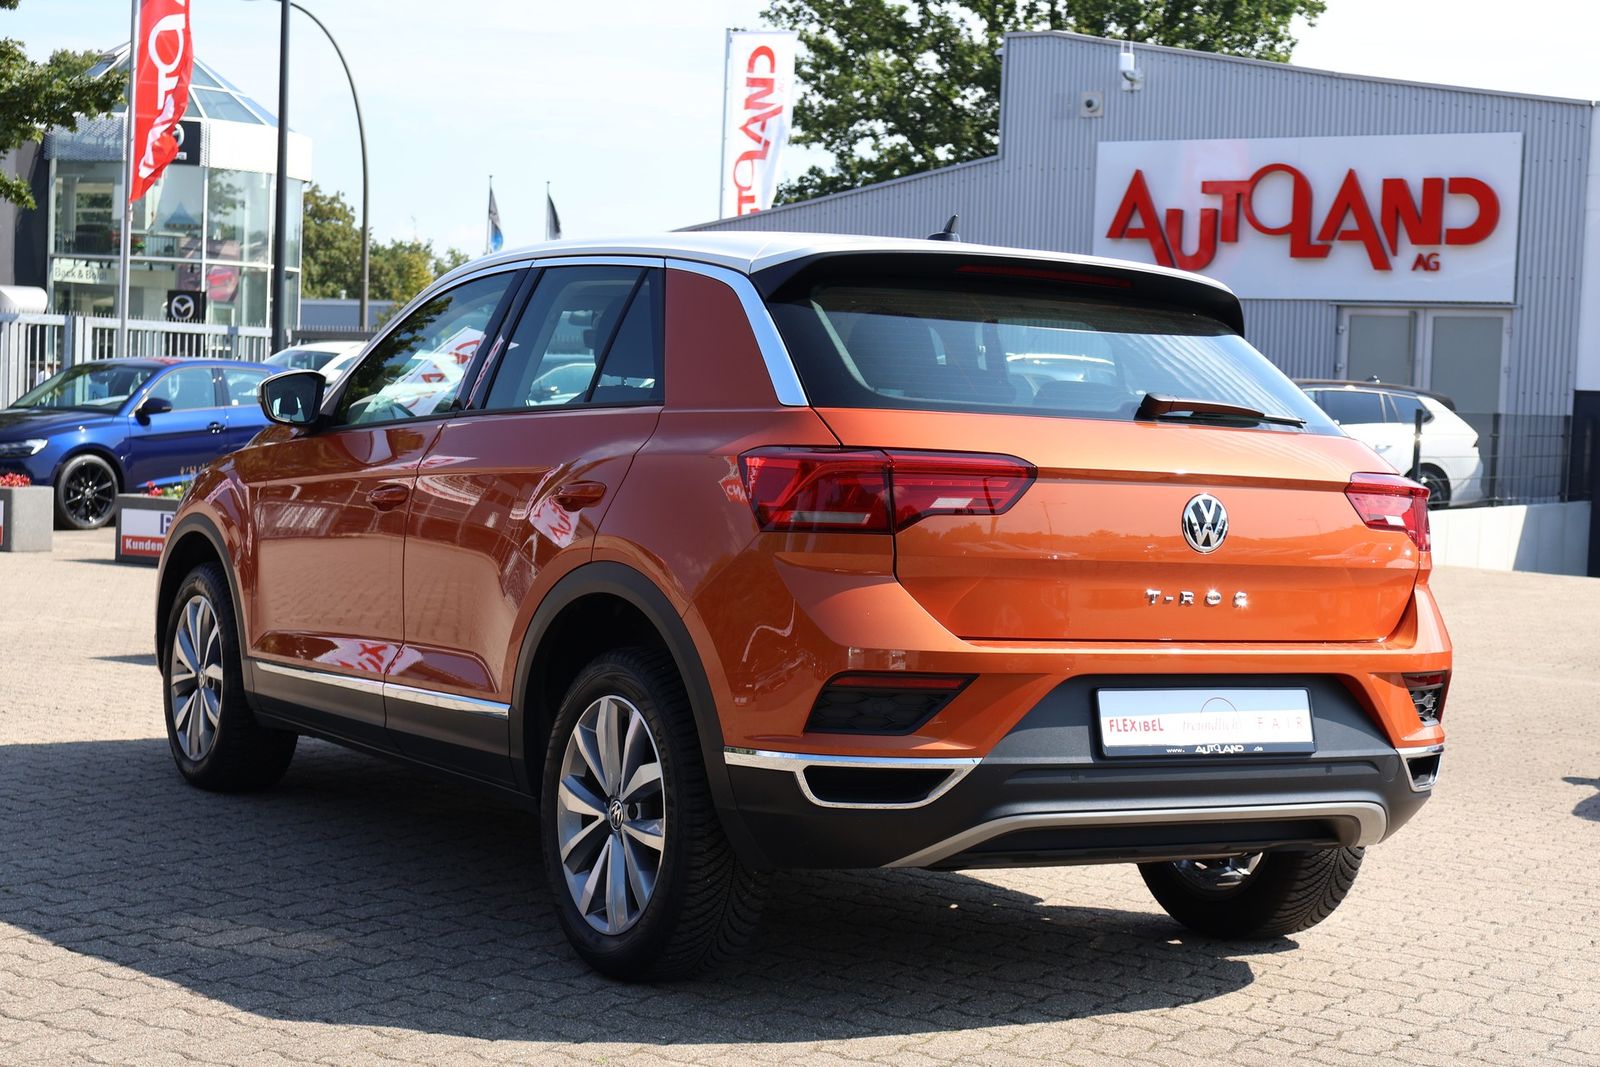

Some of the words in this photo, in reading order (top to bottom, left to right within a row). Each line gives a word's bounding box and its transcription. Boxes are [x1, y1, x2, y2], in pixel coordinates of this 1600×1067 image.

[1106, 163, 1500, 271] AUTOLAND
[1411, 252, 1440, 272] AG
[1109, 717, 1164, 732] FLEXIBEL
